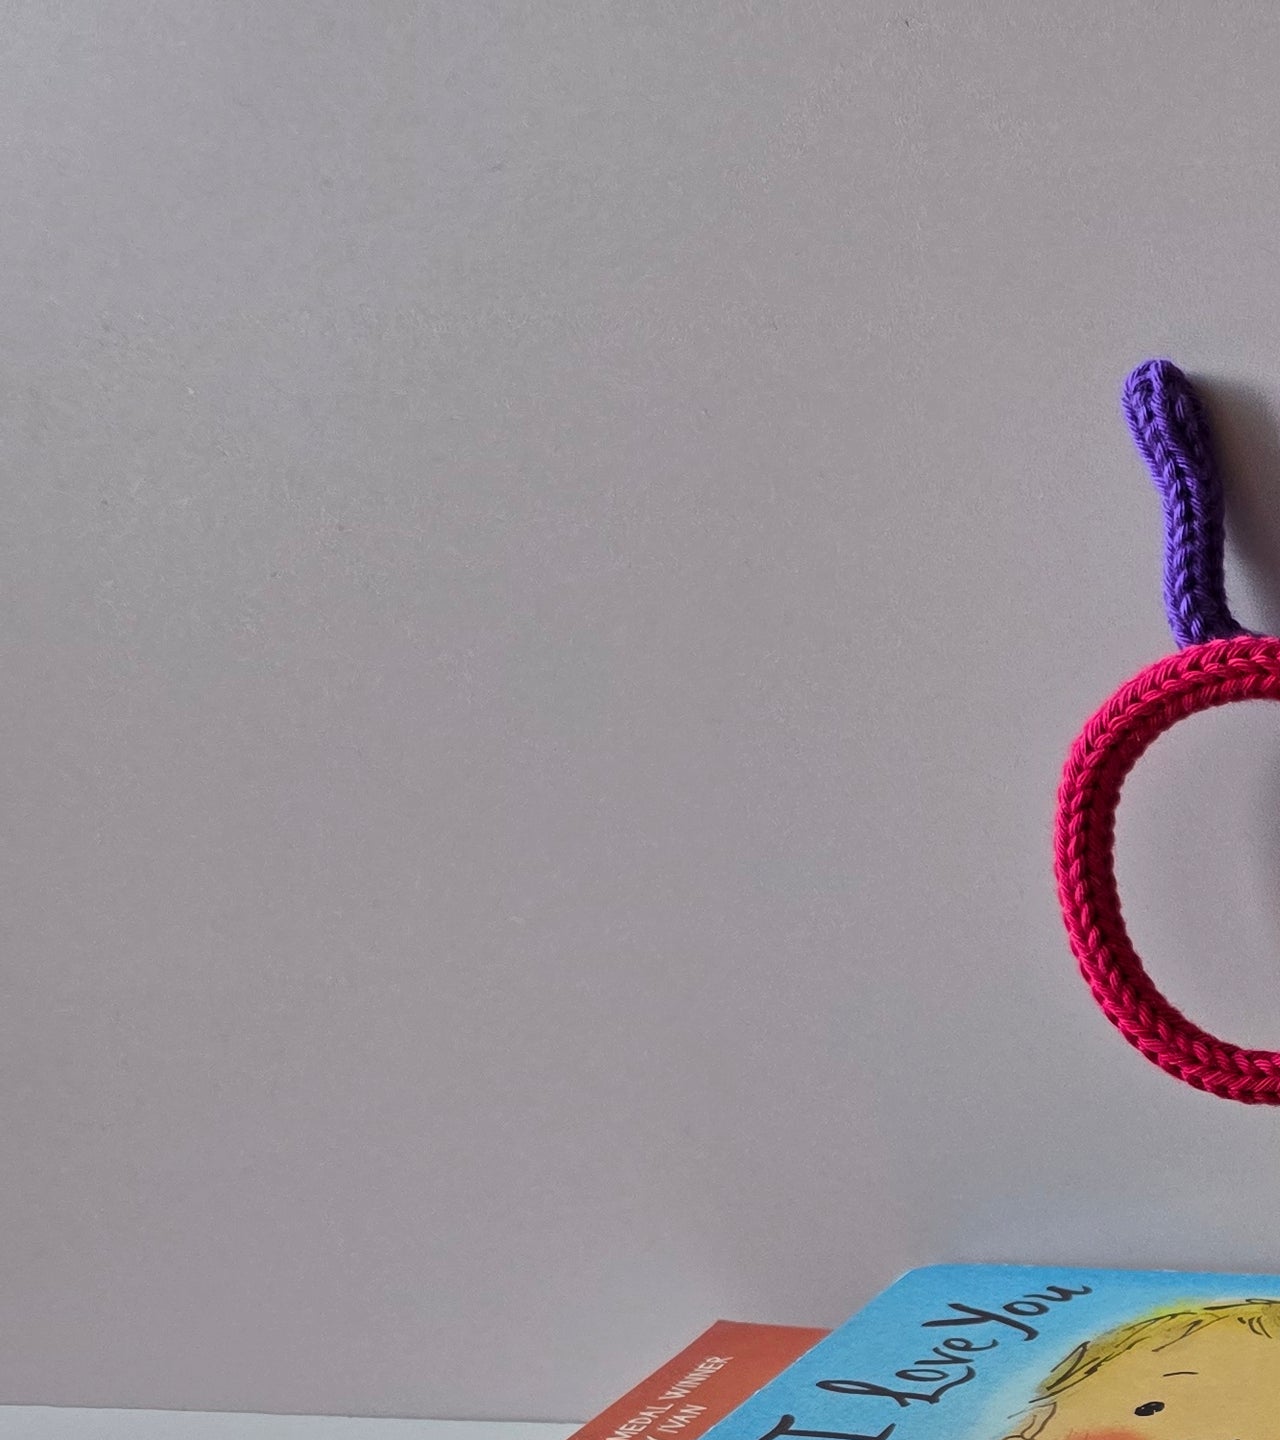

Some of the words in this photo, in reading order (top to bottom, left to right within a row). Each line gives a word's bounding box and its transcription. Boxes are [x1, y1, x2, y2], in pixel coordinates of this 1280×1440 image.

[815, 1337, 998, 1408] Love
[921, 1284, 1093, 1342] You
[659, 1355, 734, 1401] WINNER
[657, 1404, 707, 1434] IVAN
